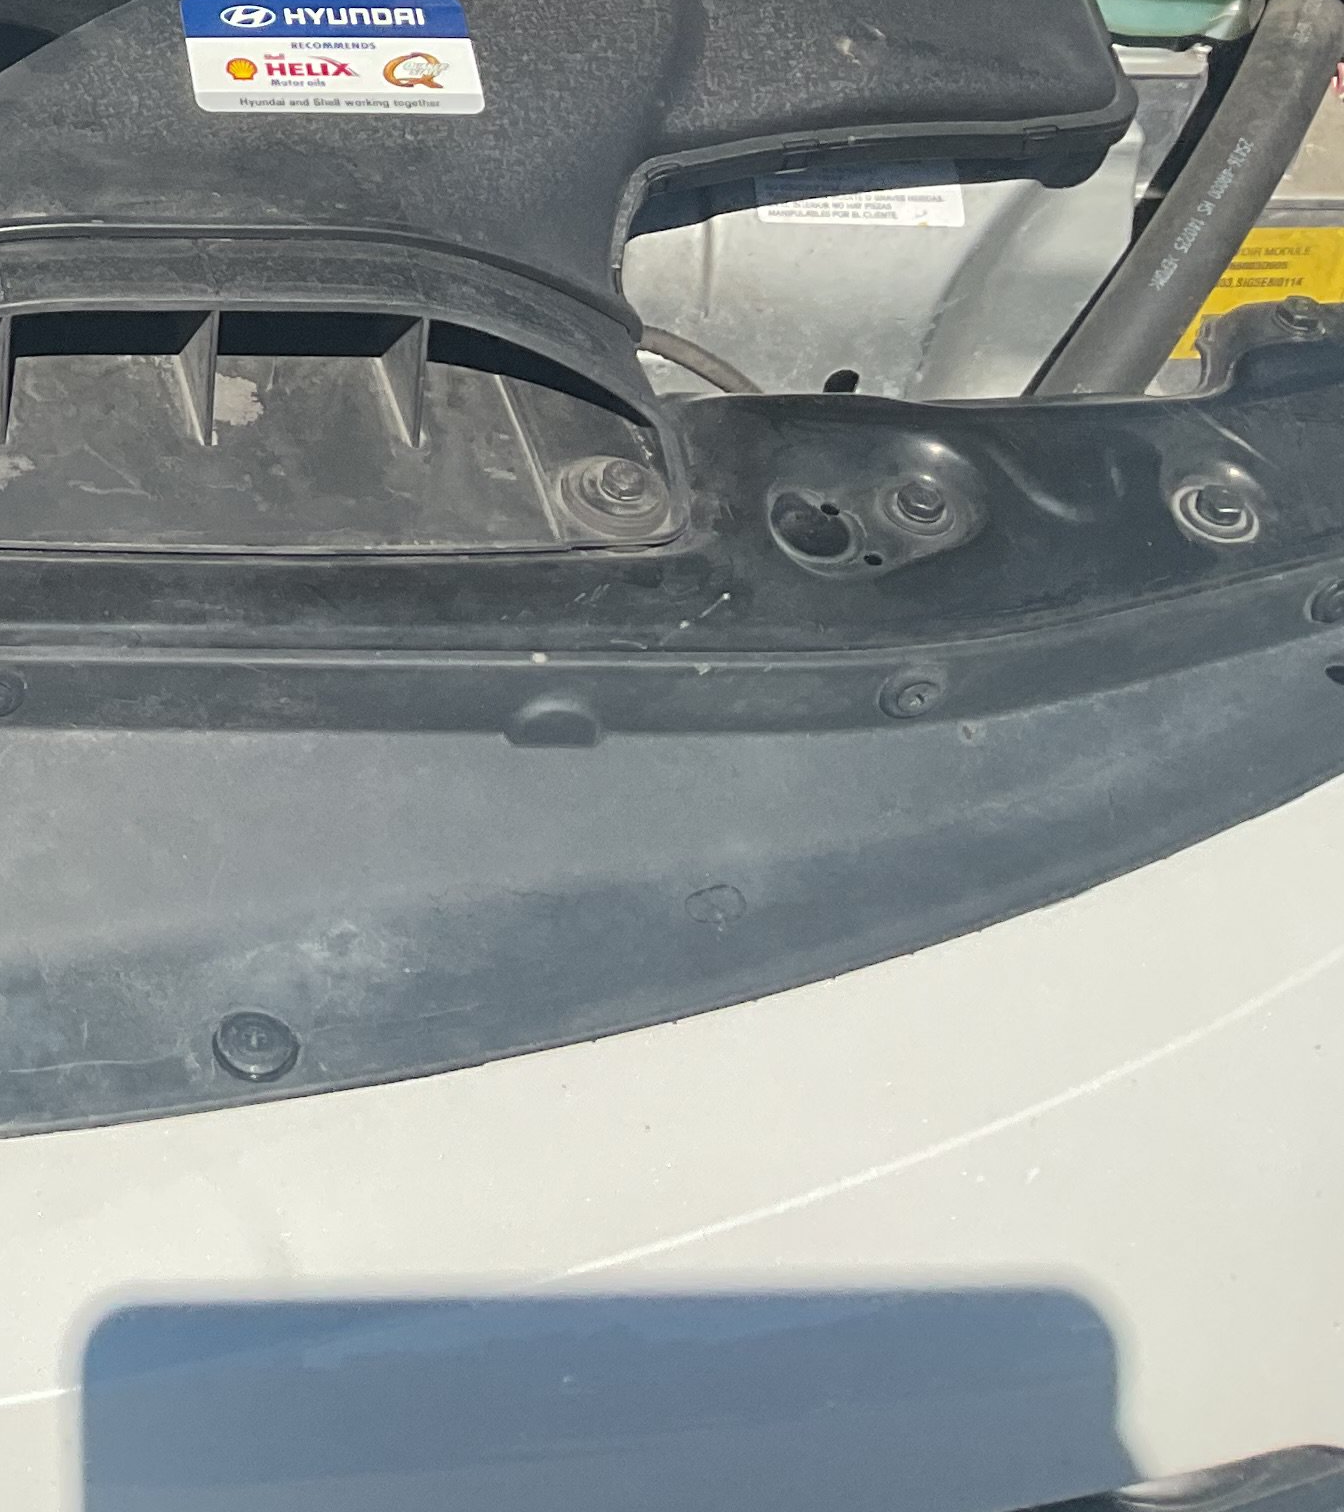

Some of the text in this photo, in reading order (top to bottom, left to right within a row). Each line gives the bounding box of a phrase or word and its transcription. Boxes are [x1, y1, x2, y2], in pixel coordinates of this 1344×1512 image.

[283, 7, 425, 26] HYUNDAI
[290, 41, 377, 50] RECOMMENDS
[265, 61, 354, 77] HELIX
[271, 78, 326, 87] Motor oils
[239, 98, 441, 109] Hyundai and Shell working together
